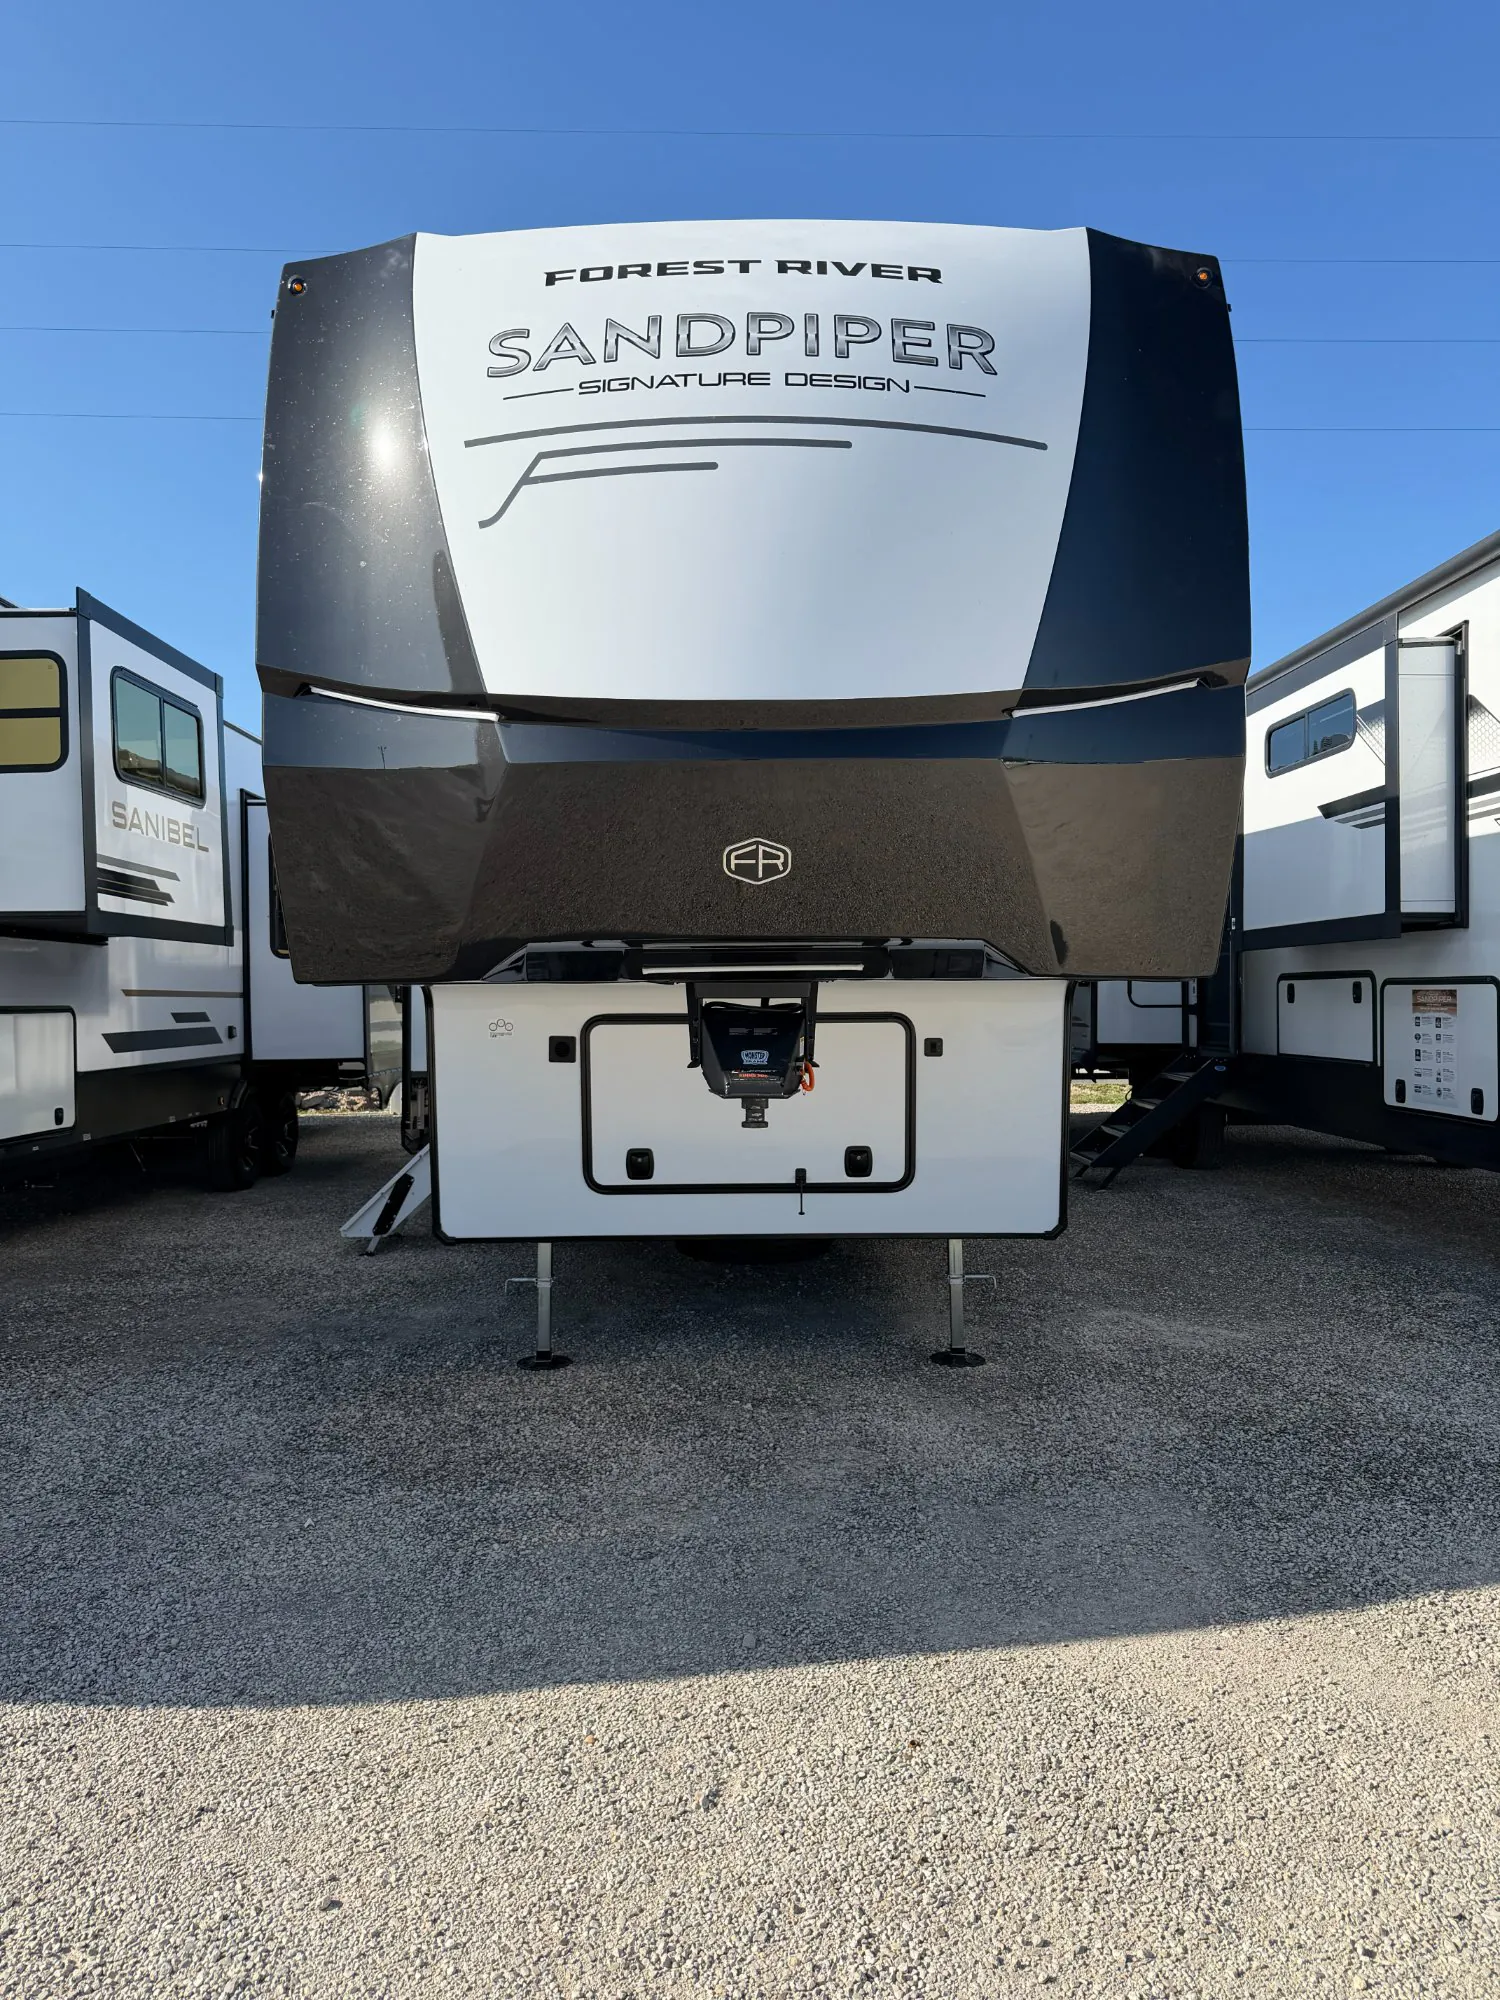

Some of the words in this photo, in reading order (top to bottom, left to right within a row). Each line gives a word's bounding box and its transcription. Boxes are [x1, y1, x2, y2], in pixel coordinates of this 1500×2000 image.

[544, 260, 762, 286] FOREST
[774, 259, 943, 284] RIVER
[486, 311, 998, 378] SANDPIPER
[578, 372, 771, 395] SIGNATURE
[784, 372, 910, 393] DESIGN
[112, 800, 209, 852] SANIBEL
[730, 844, 785, 878] FR
